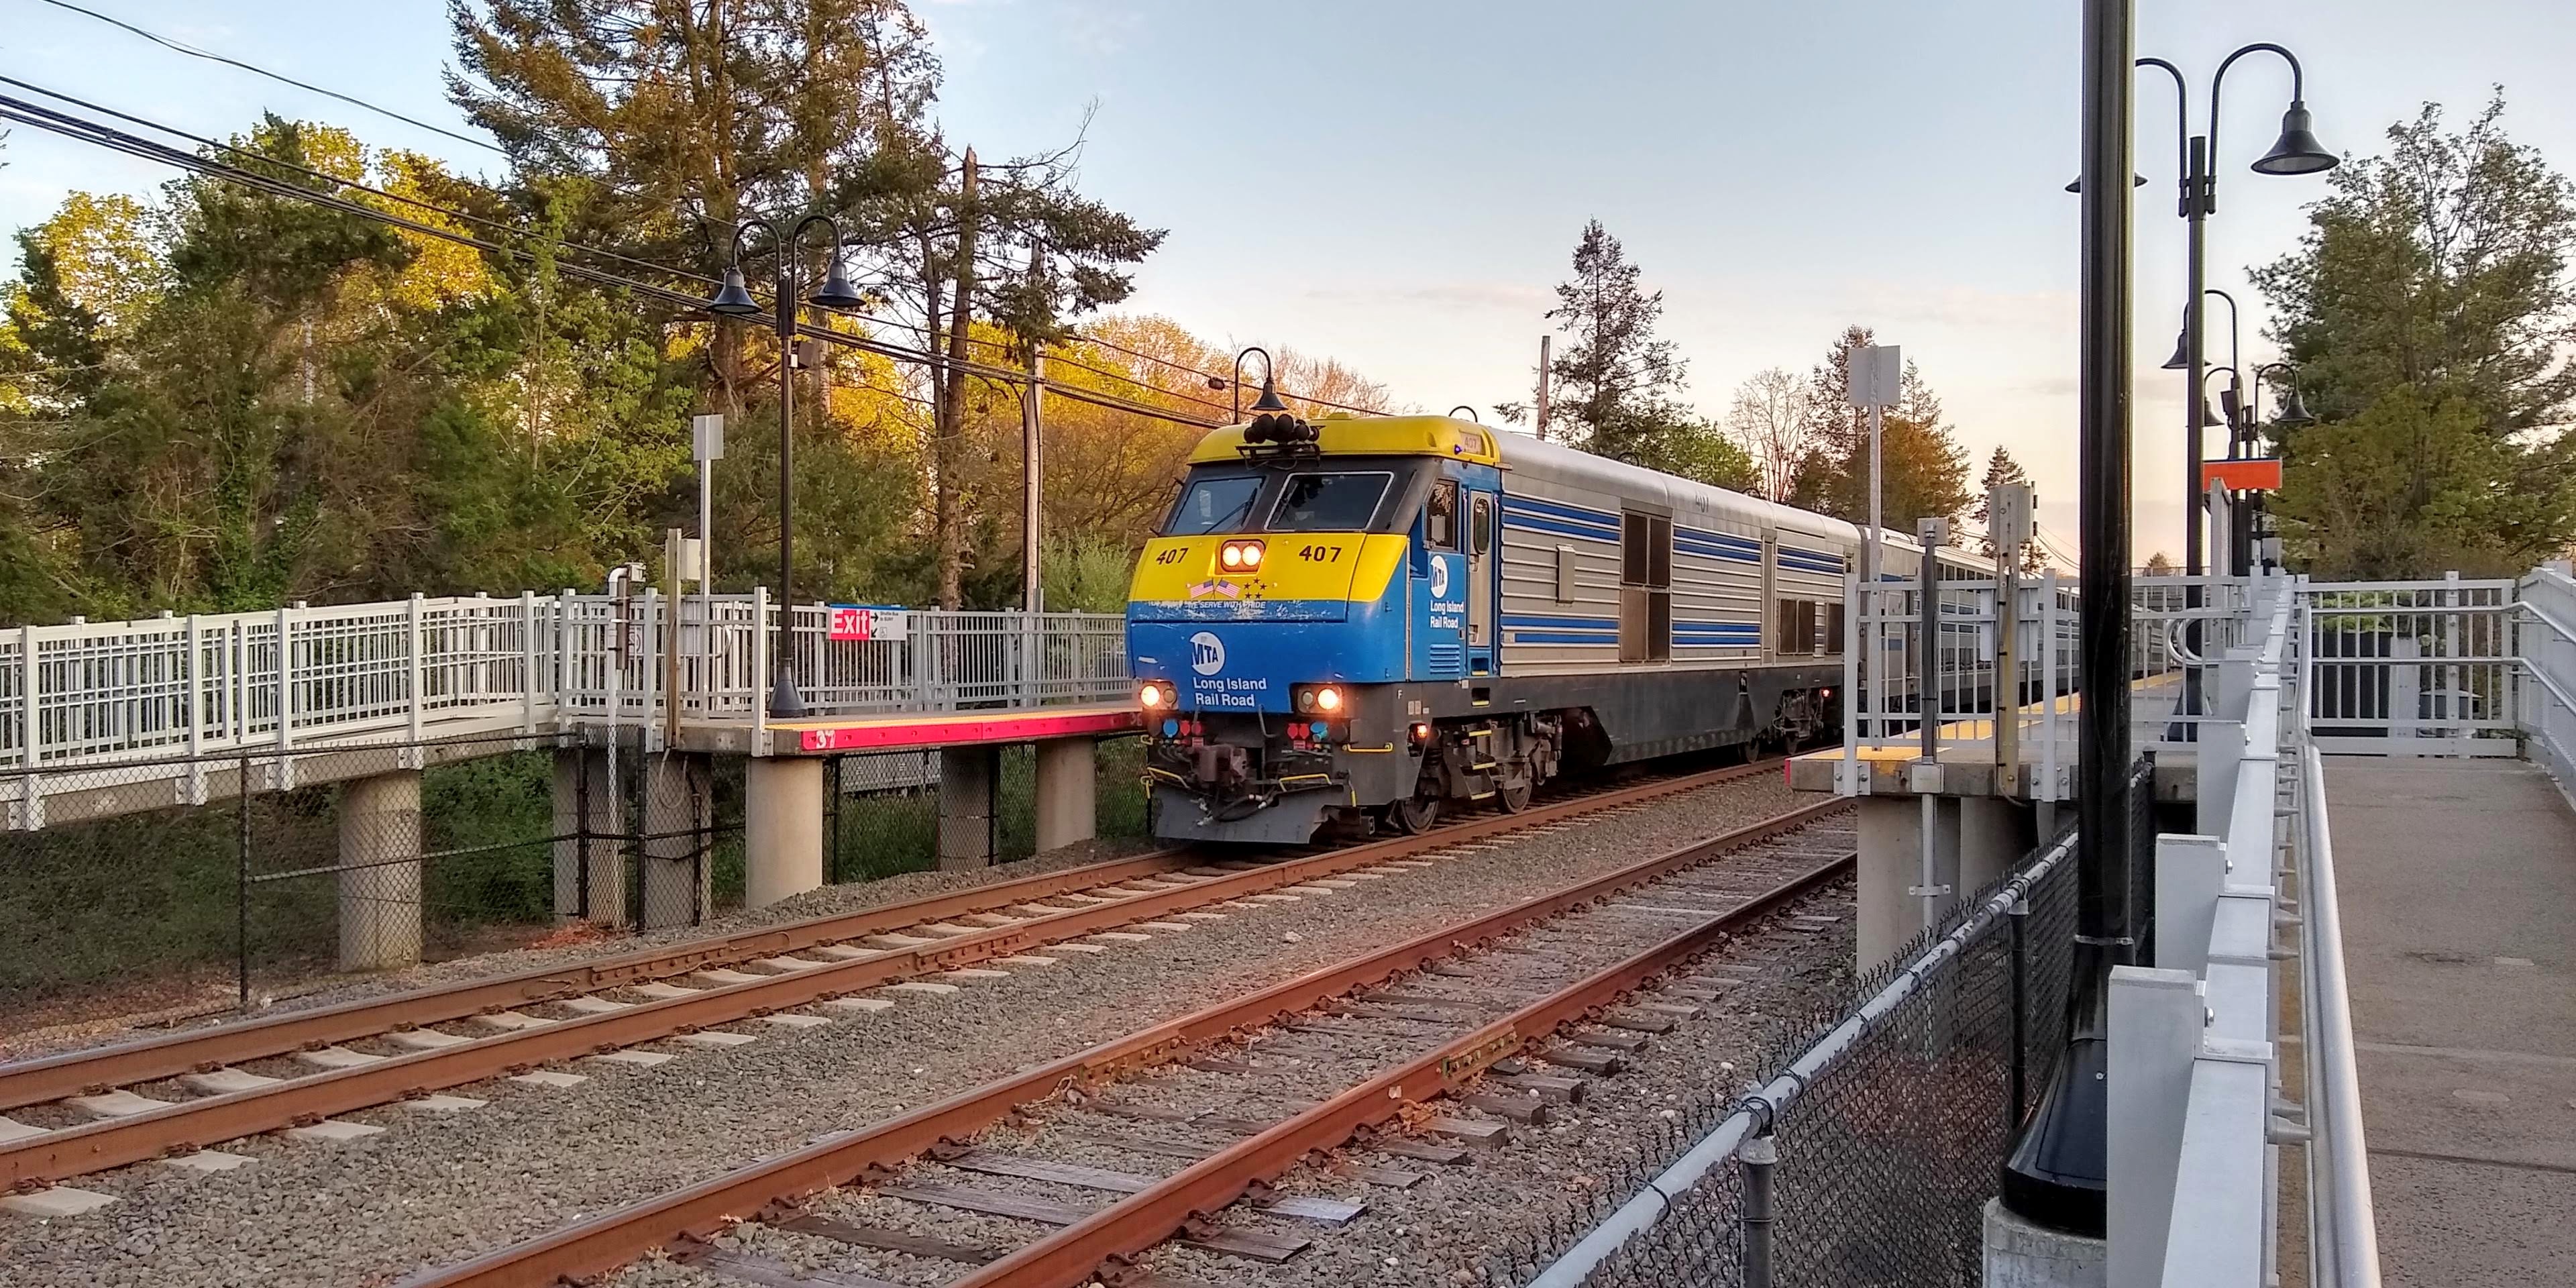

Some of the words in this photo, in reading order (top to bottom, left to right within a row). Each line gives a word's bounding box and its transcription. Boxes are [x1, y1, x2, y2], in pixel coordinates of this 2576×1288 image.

[1464, 436, 1477, 449] 407
[1156, 547, 1189, 565] 407
[1299, 545, 1342, 563] 407
[1431, 566, 1445, 588] MTA
[1242, 601, 1266, 609] PRIDE
[1430, 600, 1446, 615] Long
[1446, 600, 1464, 613] Island
[830, 608, 869, 635] Exit
[1430, 616, 1442, 628] Rail
[1443, 616, 1458, 629] Road
[1191, 643, 1219, 666] MTA
[1193, 676, 1225, 692] Long
[1226, 678, 1267, 690] Island
[1195, 692, 1220, 706] Rail
[1221, 694, 1255, 707] Road
[1397, 689, 1403, 700] F
